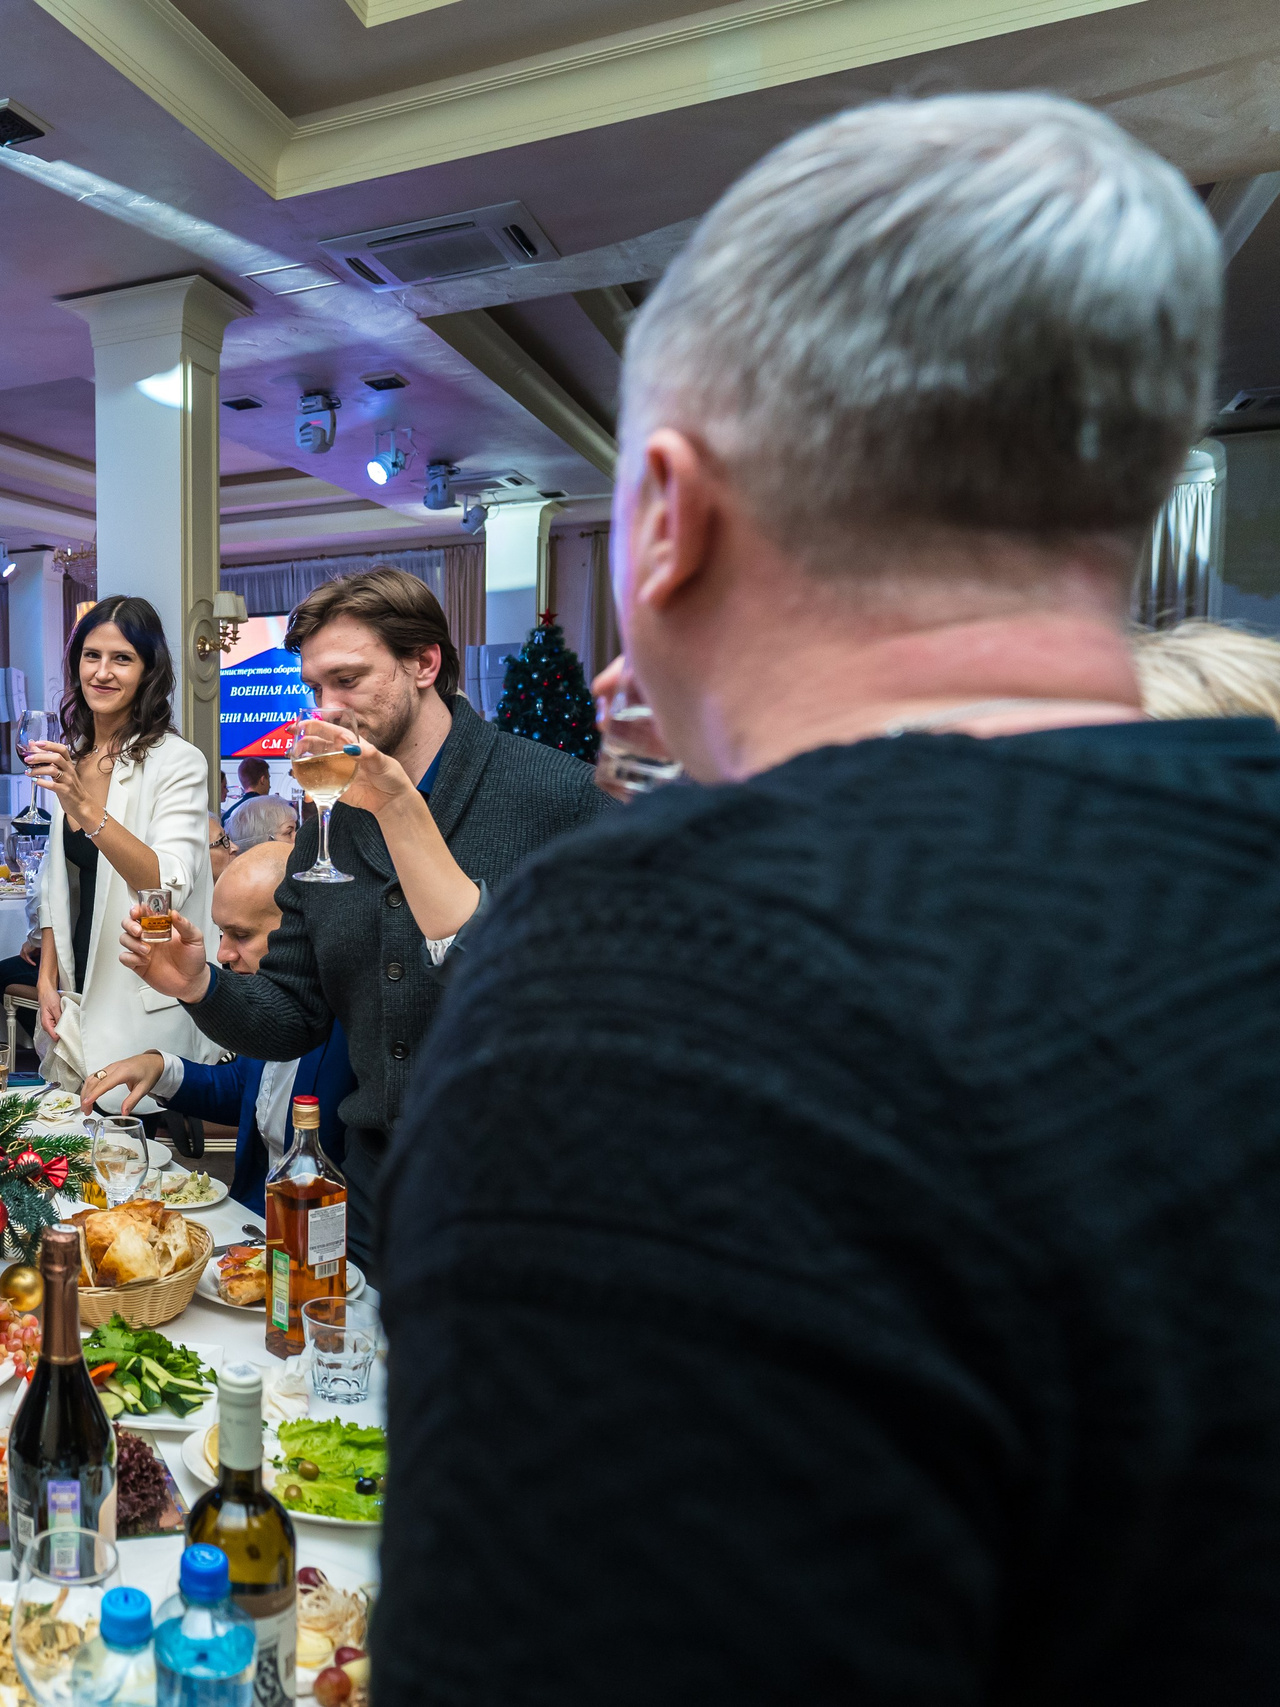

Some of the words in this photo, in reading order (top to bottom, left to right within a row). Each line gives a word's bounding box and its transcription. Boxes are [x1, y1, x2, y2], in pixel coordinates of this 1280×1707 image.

[230, 684, 282, 697] ВОЕННАЯ
[242, 711, 297, 723] МАРШАЛА
[261, 738, 283, 749] С.М.
